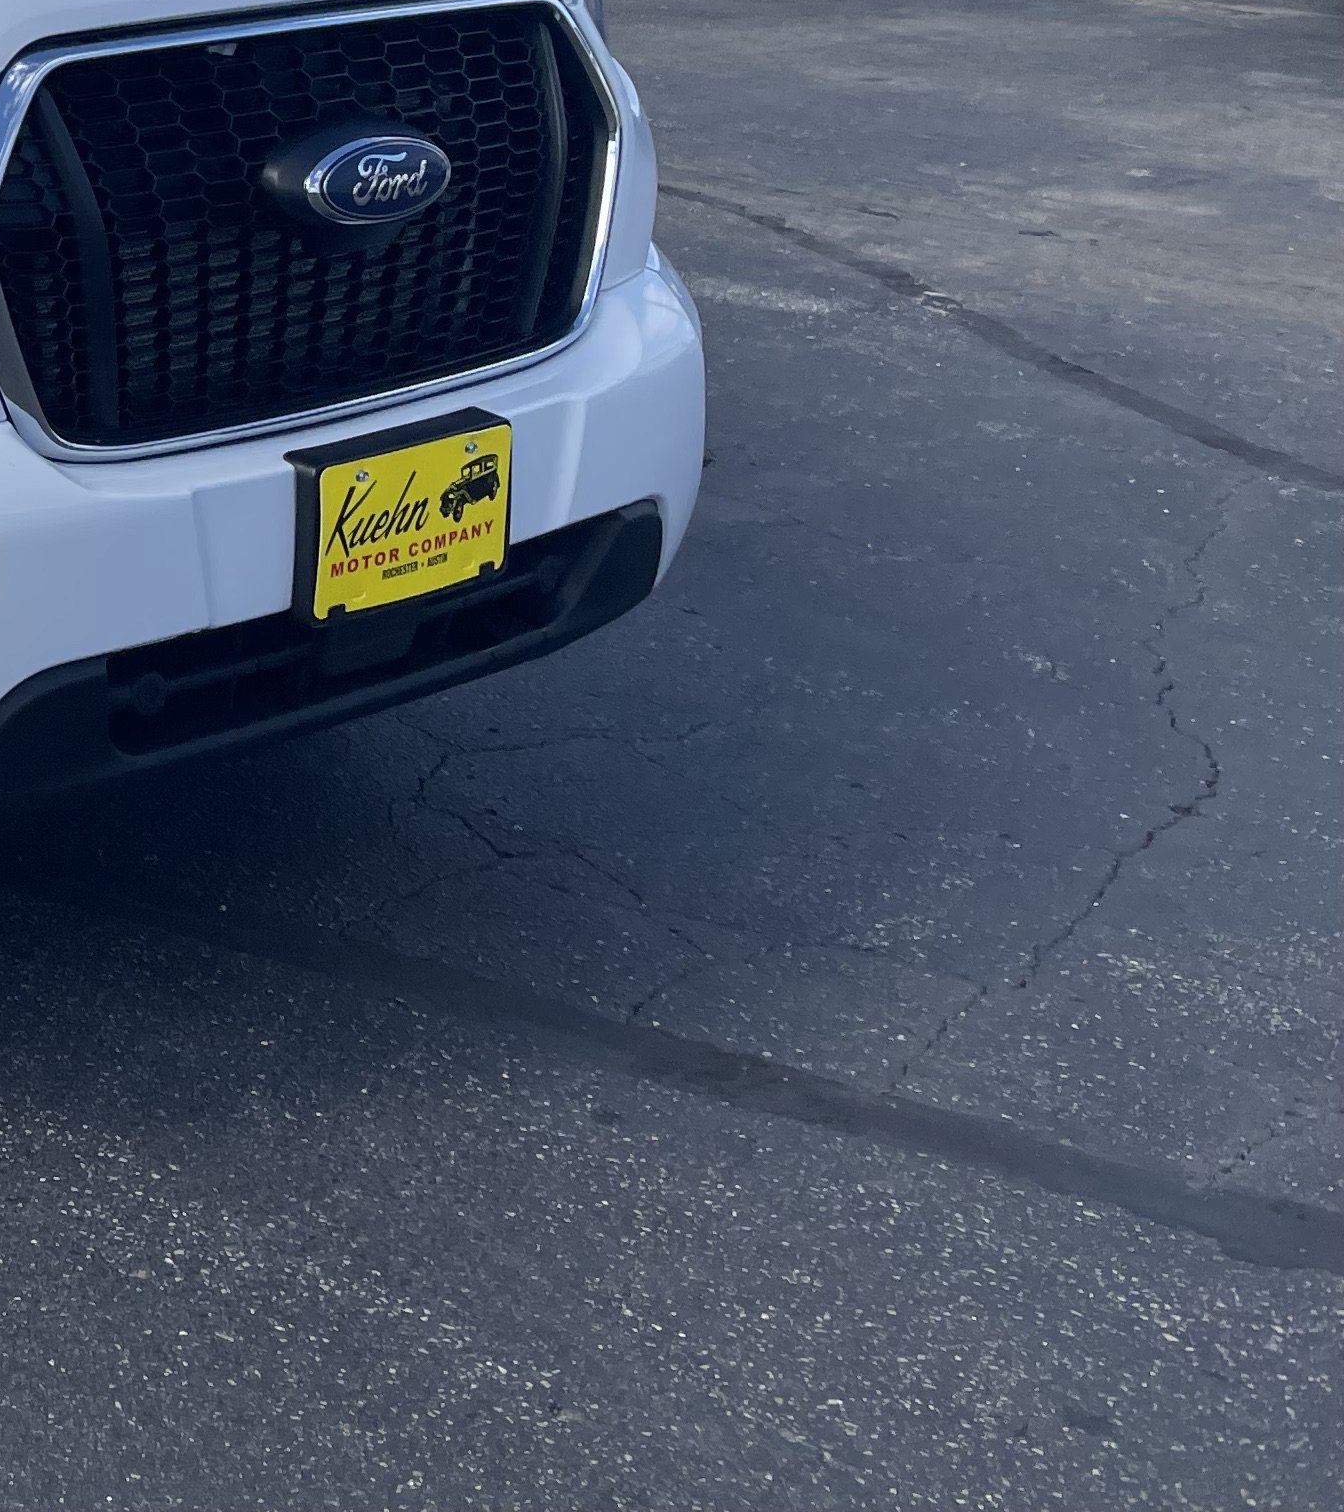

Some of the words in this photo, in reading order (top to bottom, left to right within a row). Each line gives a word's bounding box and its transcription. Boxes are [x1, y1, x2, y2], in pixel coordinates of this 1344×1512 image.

[352, 151, 428, 206] Ford
[325, 470, 430, 558] Kuehn
[330, 548, 400, 578] MOTOR
[408, 519, 495, 557] COMPANY
[382, 561, 419, 581] ROCHESTER
[427, 552, 449, 568] AUSTIN
